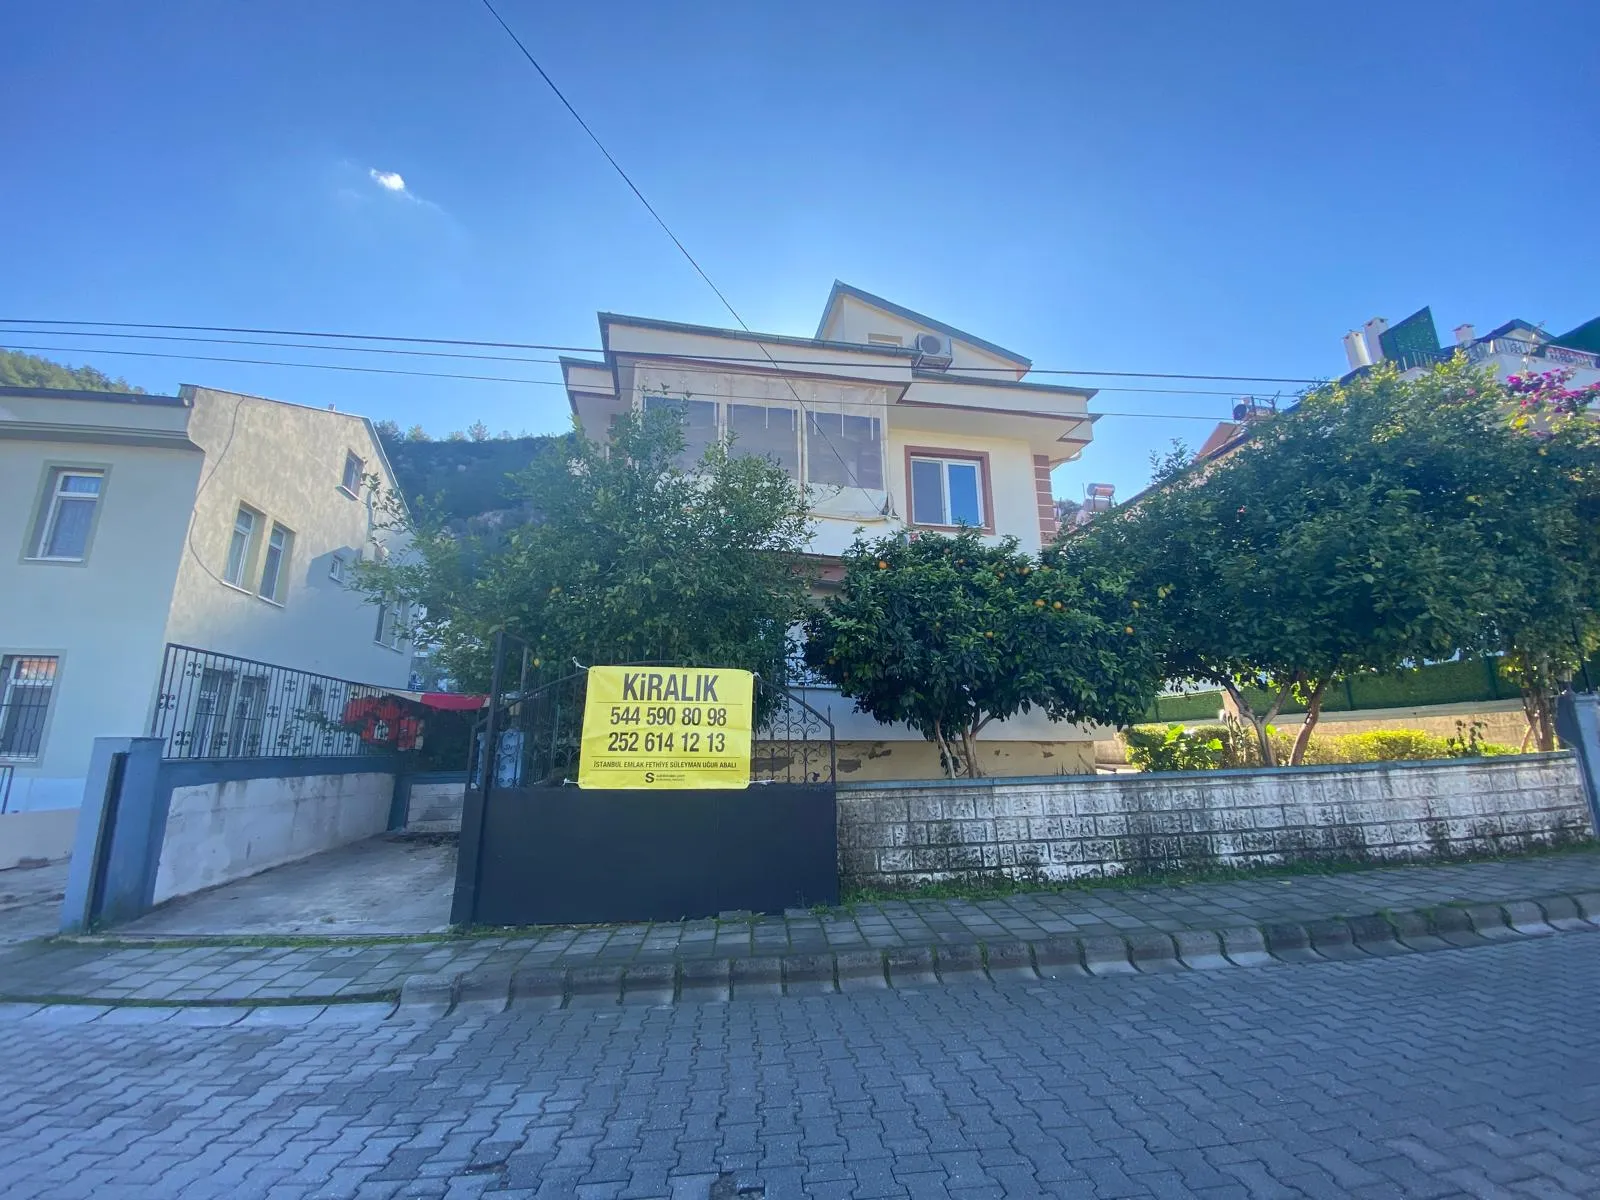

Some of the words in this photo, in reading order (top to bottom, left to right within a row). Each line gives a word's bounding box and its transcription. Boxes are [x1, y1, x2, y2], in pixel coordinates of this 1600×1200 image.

[610, 706, 641, 726] 544
[646, 706, 676, 726] 590
[681, 707, 702, 726] 80
[707, 707, 727, 727] 98
[608, 731, 639, 752] 252
[644, 732, 674, 752] 614
[682, 732, 699, 752] 12
[707, 732, 725, 753] 13
